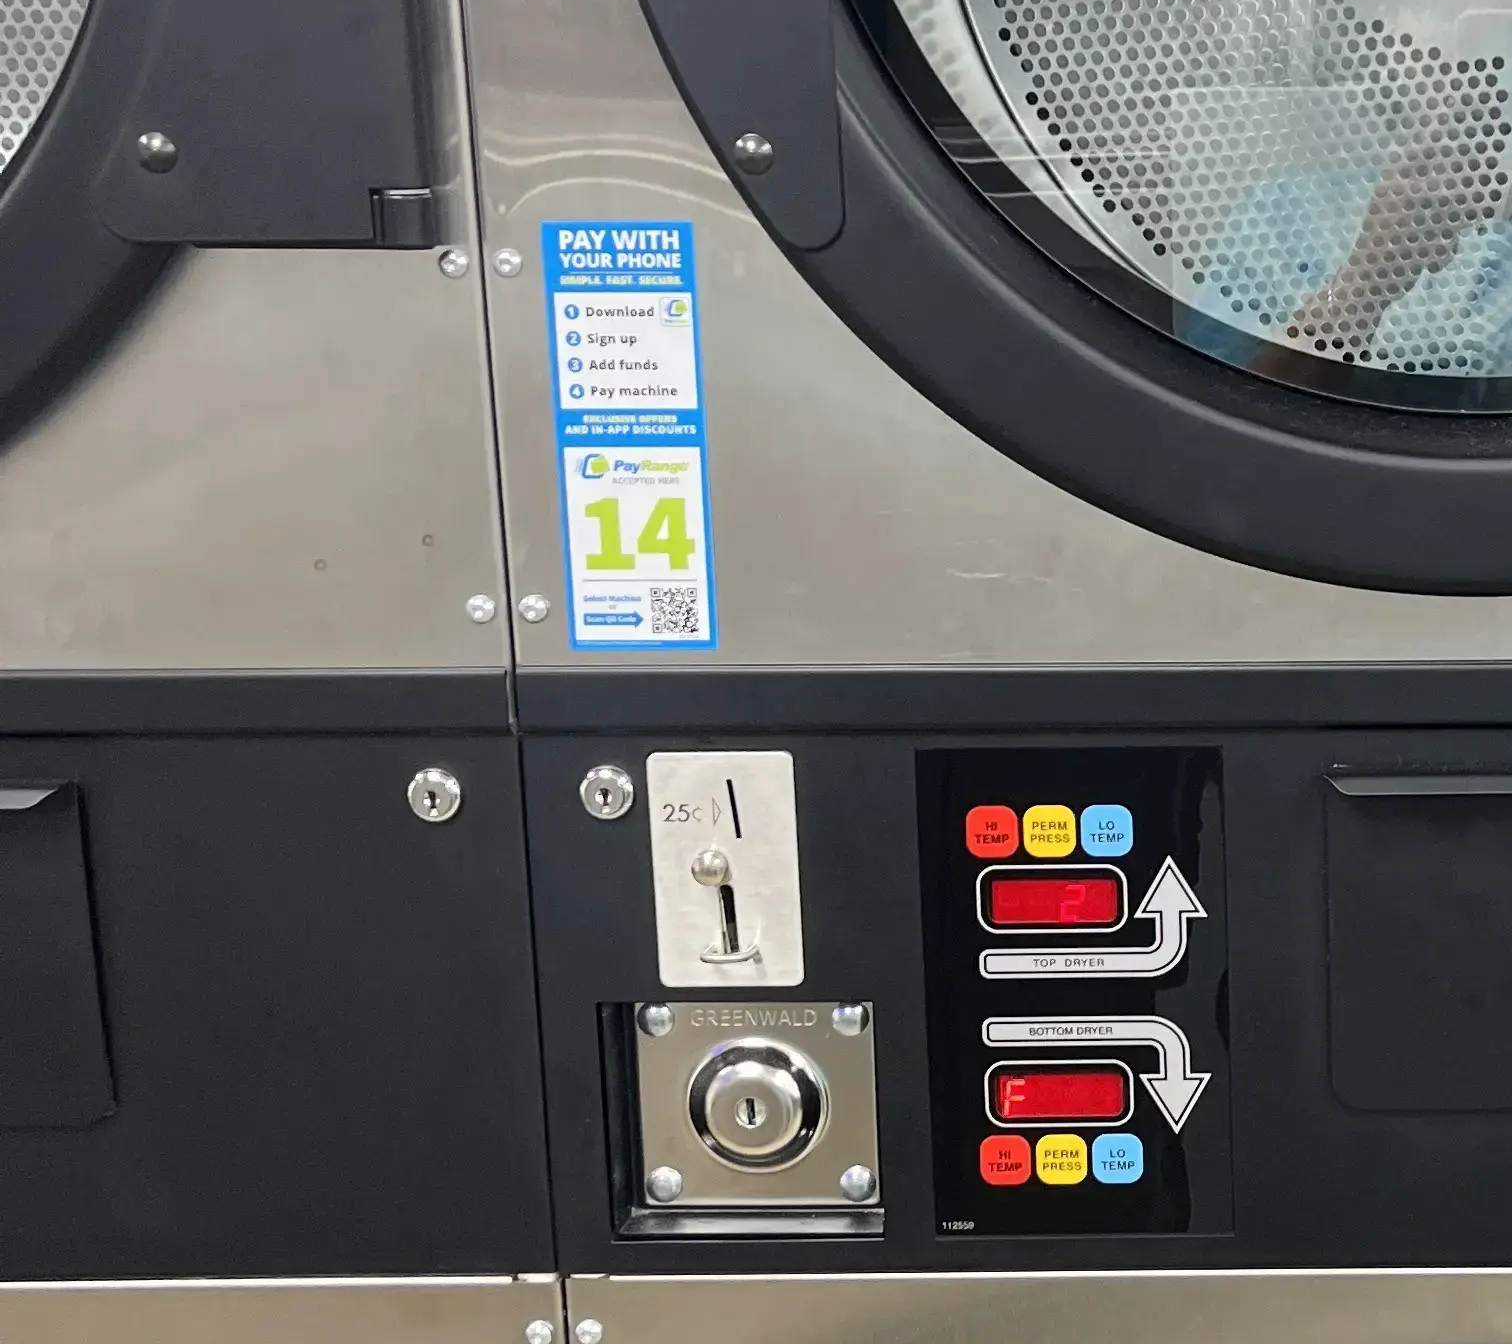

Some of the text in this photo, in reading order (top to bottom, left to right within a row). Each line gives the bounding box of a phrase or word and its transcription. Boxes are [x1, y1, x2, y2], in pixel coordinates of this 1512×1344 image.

[558, 229, 680, 250] PAY WITH
[559, 253, 682, 268] YOUR PHONE
[586, 306, 655, 317] Download
[587, 333, 616, 347] Sign
[620, 335, 638, 347] up
[589, 359, 616, 371] Add
[619, 359, 659, 371] funds
[590, 386, 615, 399] Pay
[619, 385, 678, 396] machine
[565, 425, 697, 435] AND IN-APP DISCOUNTS
[613, 460, 689, 475] PayRange
[612, 476, 655, 485] ACCEPTED
[584, 497, 696, 570] 14
[985, 821, 998, 832] HI
[1031, 821, 1068, 832] PERM
[1098, 821, 1115, 831] LO
[974, 834, 1010, 844] TEMP
[1030, 833, 1071, 844] PRESS
[1089, 833, 1125, 843] TEMP
[1033, 958, 1105, 968] TOP DRYER
[689, 1008, 818, 1027] GREENWALD
[1029, 1026, 1113, 1036] BOTTOM DRYER
[998, 1149, 1011, 1160] HI
[1044, 1149, 1080, 1159] PERM
[1109, 1148, 1126, 1159] LO
[988, 1162, 1023, 1173] TEMP
[1042, 1161, 1082, 1171] PRESS
[1101, 1160, 1136, 1171] TEMP
